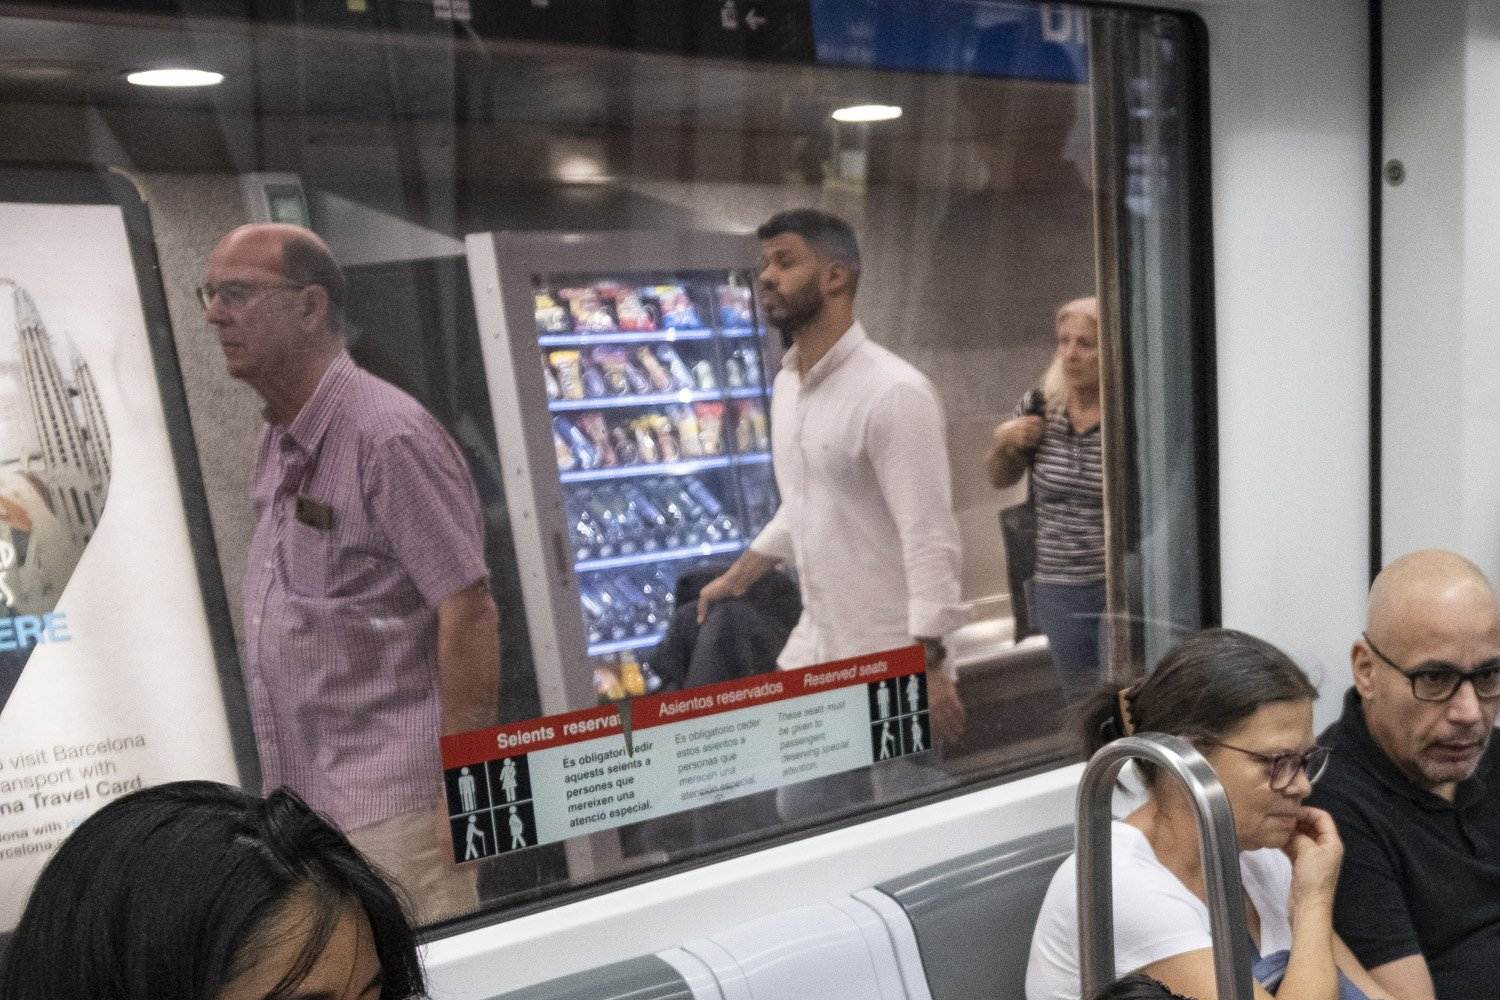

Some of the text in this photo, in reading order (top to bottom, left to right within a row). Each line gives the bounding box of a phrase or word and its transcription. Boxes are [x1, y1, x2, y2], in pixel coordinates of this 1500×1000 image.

[803, 660, 888, 688] Reserved seats
[659, 682, 784, 717] Asientos reservados
[497, 726, 555, 749] Seients
[10, 734, 145, 769] visit Barcelona
[578, 746, 627, 765] obligatori
[79, 760, 117, 779] with
[564, 758, 651, 784] aquests seients a
[29, 785, 91, 810] Travel
[96, 775, 142, 797] Card
[566, 776, 634, 800] persones que
[568, 791, 635, 813] mereixen una
